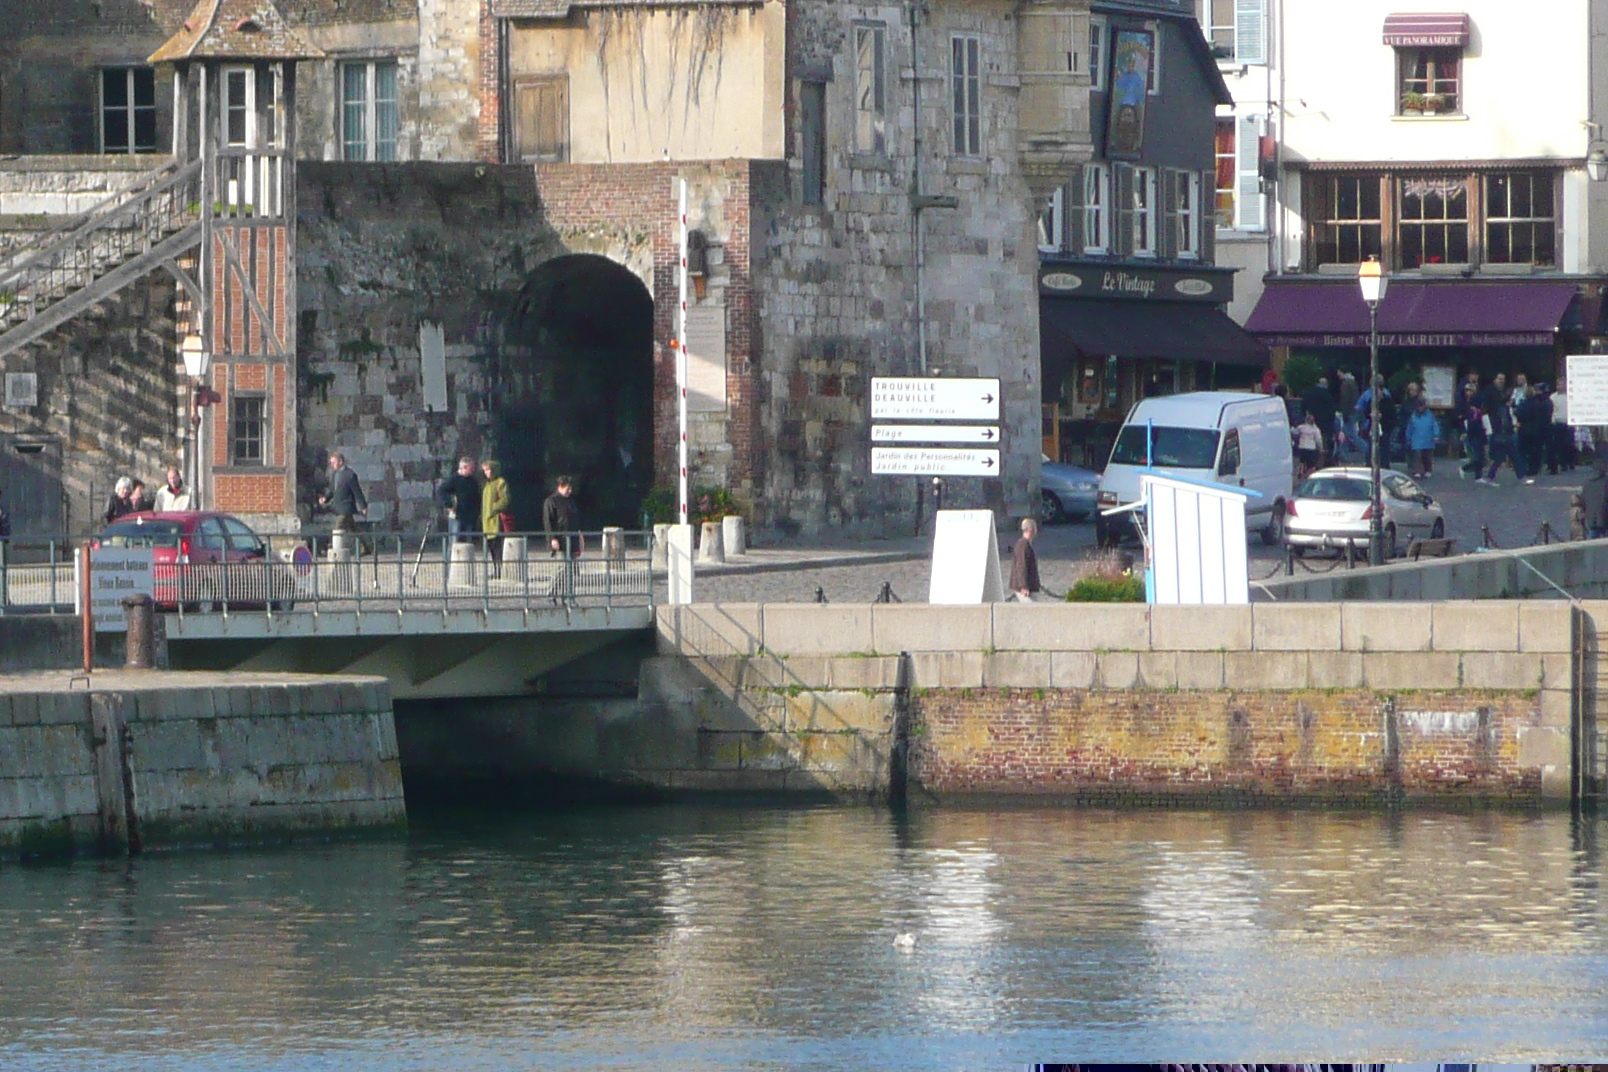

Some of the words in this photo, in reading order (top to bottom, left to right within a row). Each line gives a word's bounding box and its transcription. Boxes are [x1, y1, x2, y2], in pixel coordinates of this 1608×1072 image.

[1384, 35, 1402, 45] VUE
[1402, 35, 1460, 45] PANORAMIQUE
[1101, 271, 1116, 292] Le
[1117, 272, 1155, 298] Vintage
[874, 382, 936, 391] TROUVILLE
[874, 394, 936, 403] DEAUVILLE
[875, 430, 903, 440] Plage
[875, 452, 901, 461] Jardin
[903, 452, 918, 461] des
[920, 452, 976, 461] Personnalités
[875, 462, 907, 471] Jardin
[913, 462, 945, 473] public
